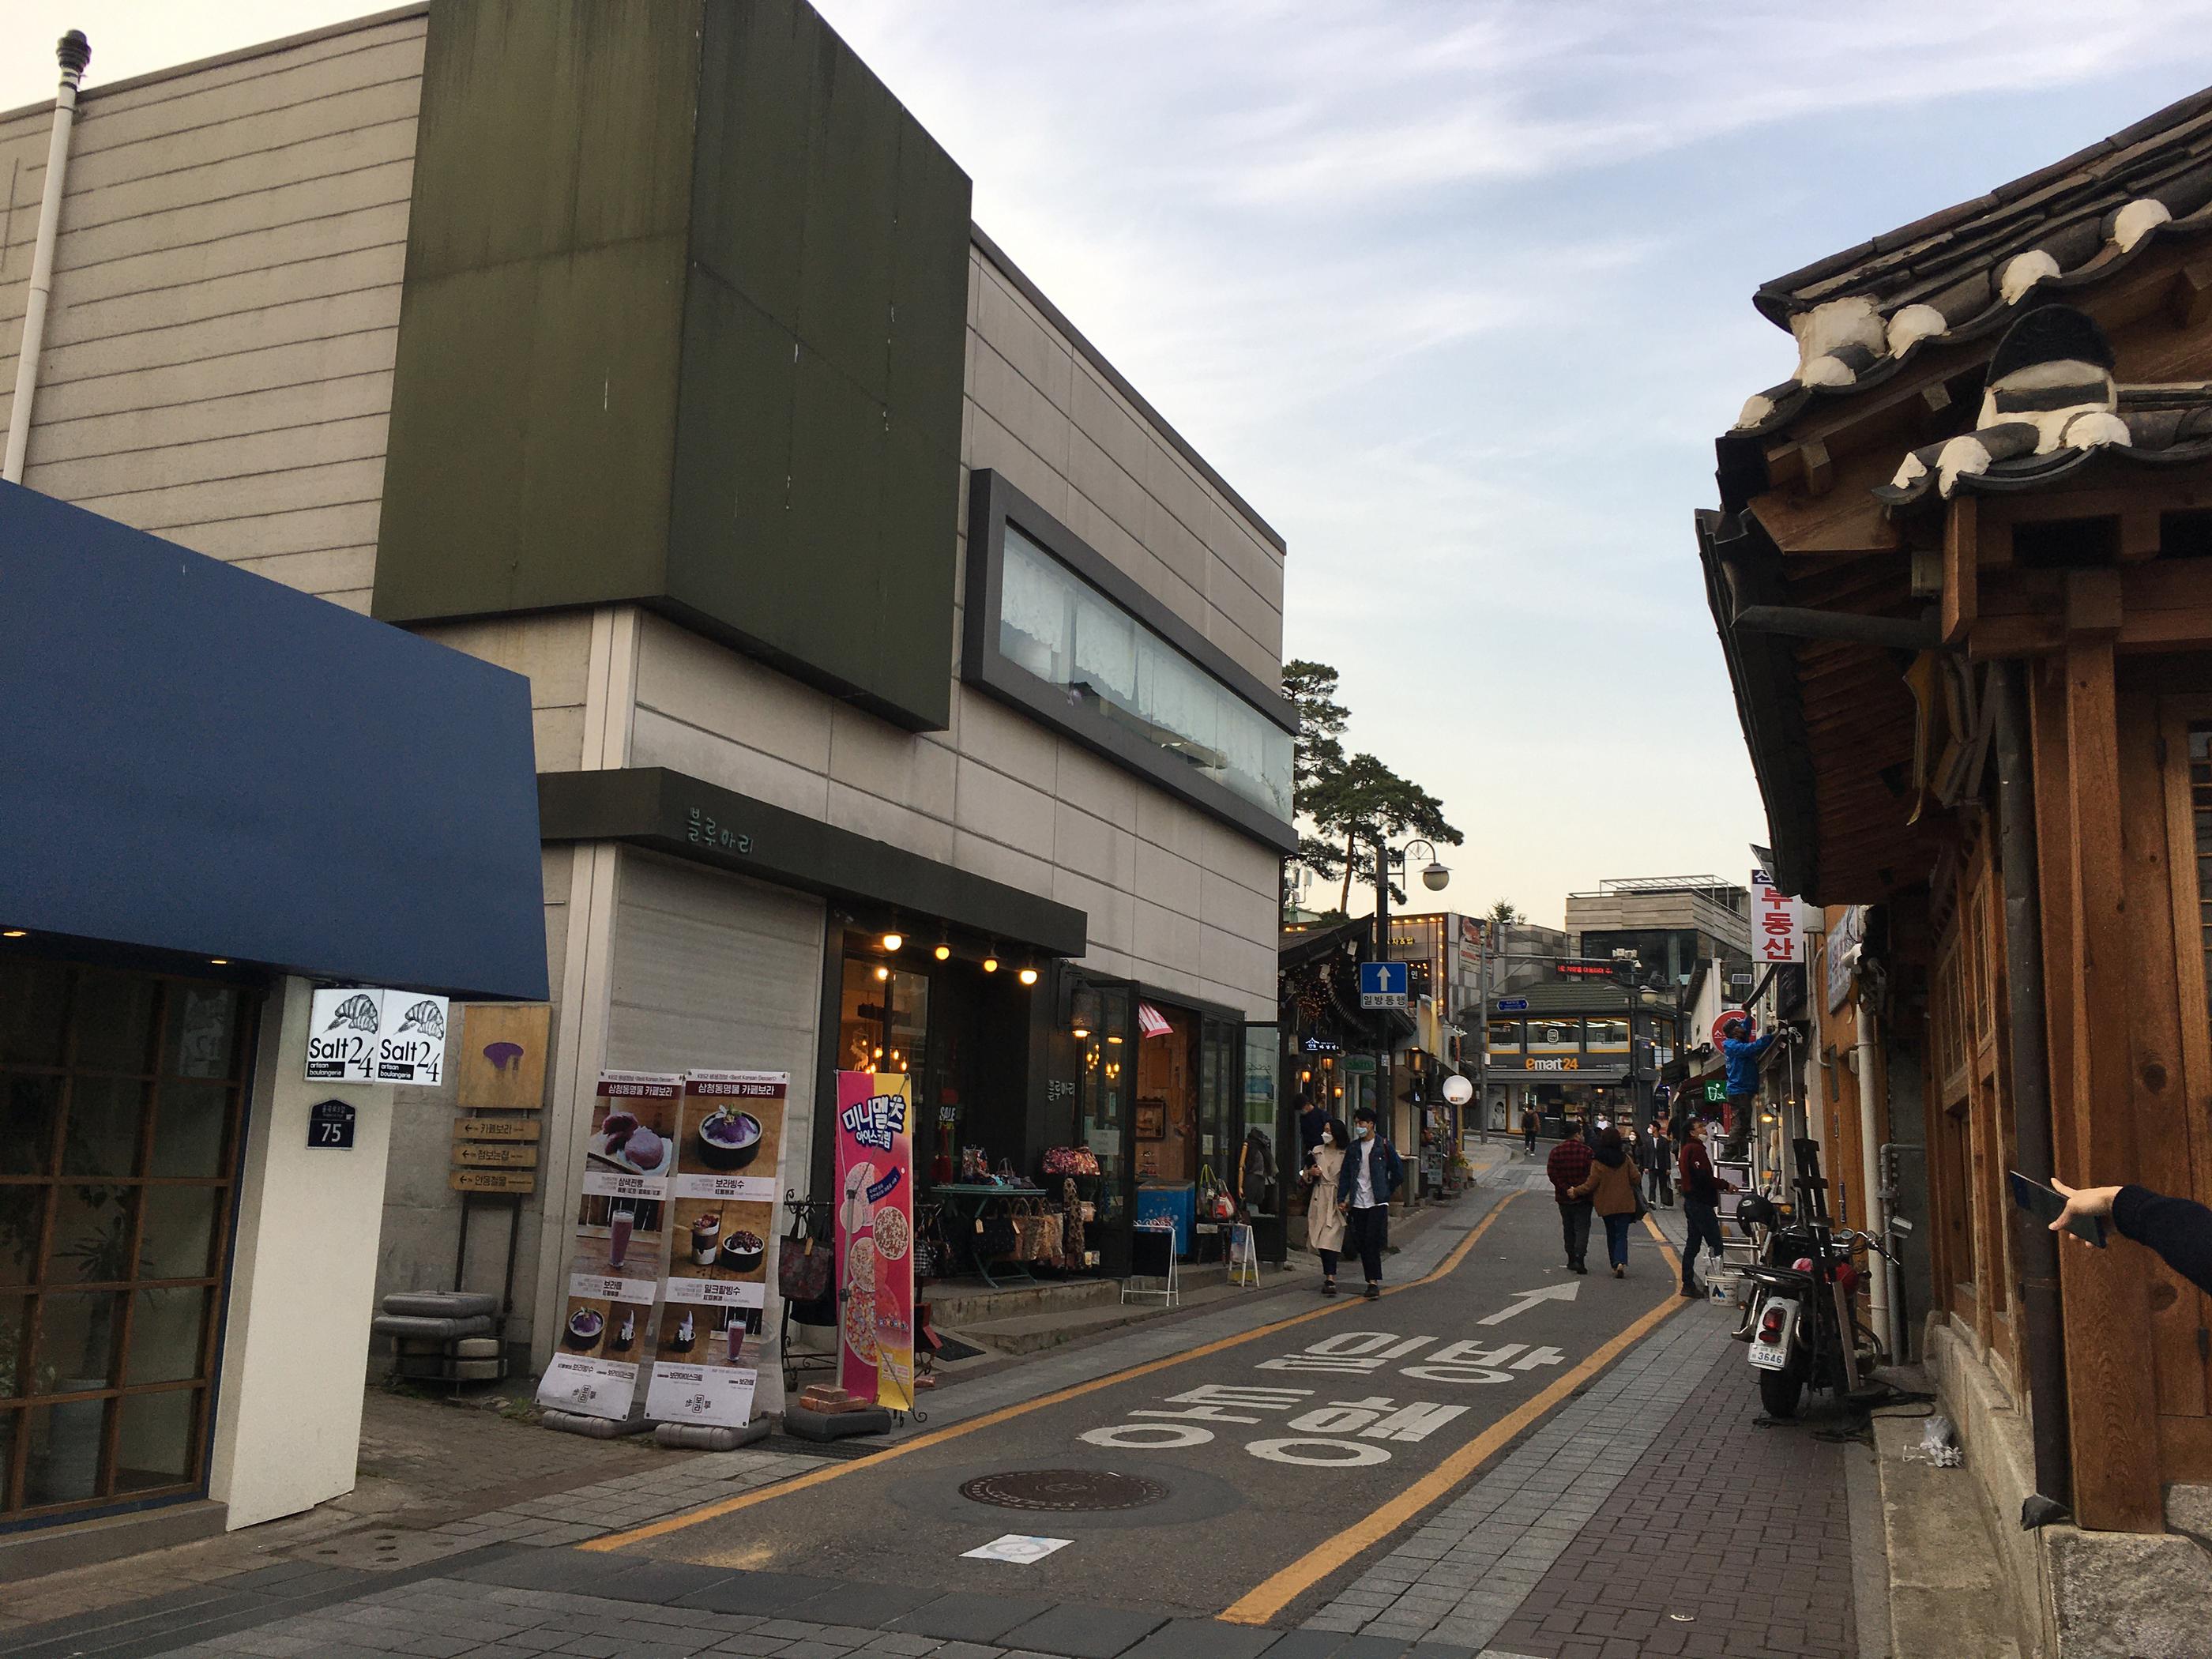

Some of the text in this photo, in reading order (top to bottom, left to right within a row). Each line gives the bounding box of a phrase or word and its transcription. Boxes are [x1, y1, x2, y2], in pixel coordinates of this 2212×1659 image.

[687, 807, 754, 853] 블루아리
[1761, 887, 1794, 960] 부동산
[1364, 995, 1405, 1006] 일방통행
[309, 1037, 348, 1059] Salt
[380, 1038, 417, 1062] Salt
[1525, 1058, 1578, 1070] emart24
[380, 1071, 412, 1080] boulangerie
[608, 1084, 673, 1097] 삼청동명물 카페보라
[698, 1083, 774, 1095] 삼청동명물 카페보라
[842, 1097, 905, 1131] 미니멜츠
[939, 1106, 956, 1122] SALE
[322, 1123, 342, 1142] 75
[856, 1130, 891, 1149] 아이스크림
[715, 1179, 745, 1189] 보라빙수
[704, 1284, 741, 1296] 밀크팥빙수
[1254, 1330, 1566, 1384] 일방
[1758, 1352, 1783, 1364] 3646
[1074, 1383, 1472, 1467] 통행
